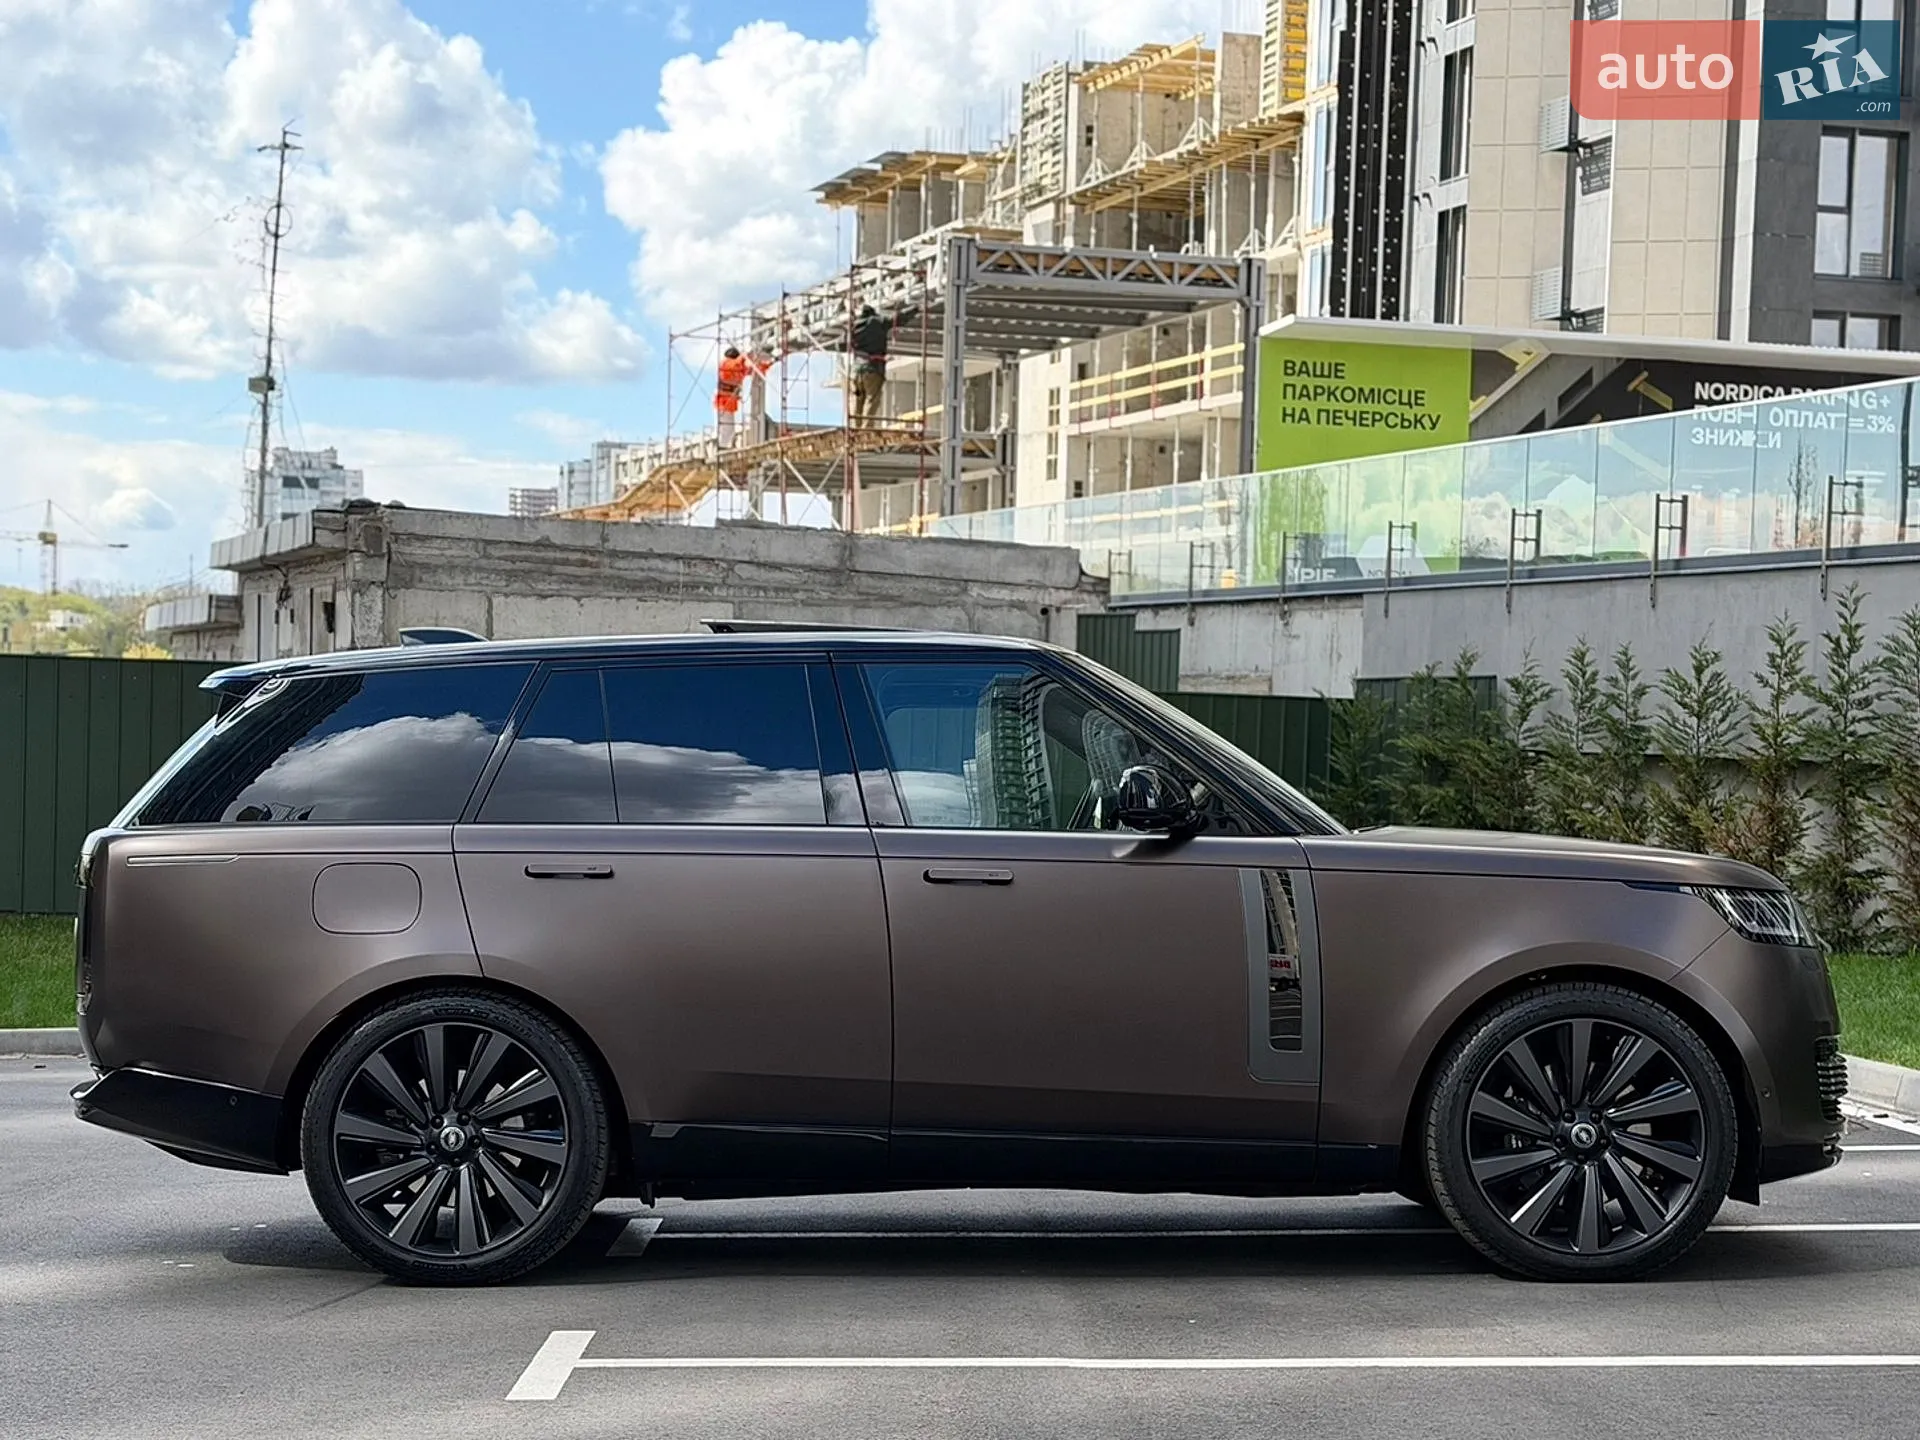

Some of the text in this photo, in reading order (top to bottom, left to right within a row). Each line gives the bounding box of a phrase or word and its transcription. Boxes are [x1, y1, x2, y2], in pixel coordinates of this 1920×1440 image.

[1283, 359, 1346, 379] ВАШЕ
[1282, 383, 1426, 409] ПАРКОМІСЦЕ
[1694, 381, 1785, 402] NORDICA
[1281, 406, 1441, 431] НА ПЕЧЕРСЬКУ
[1691, 426, 1782, 449] ЗНИЖИ
